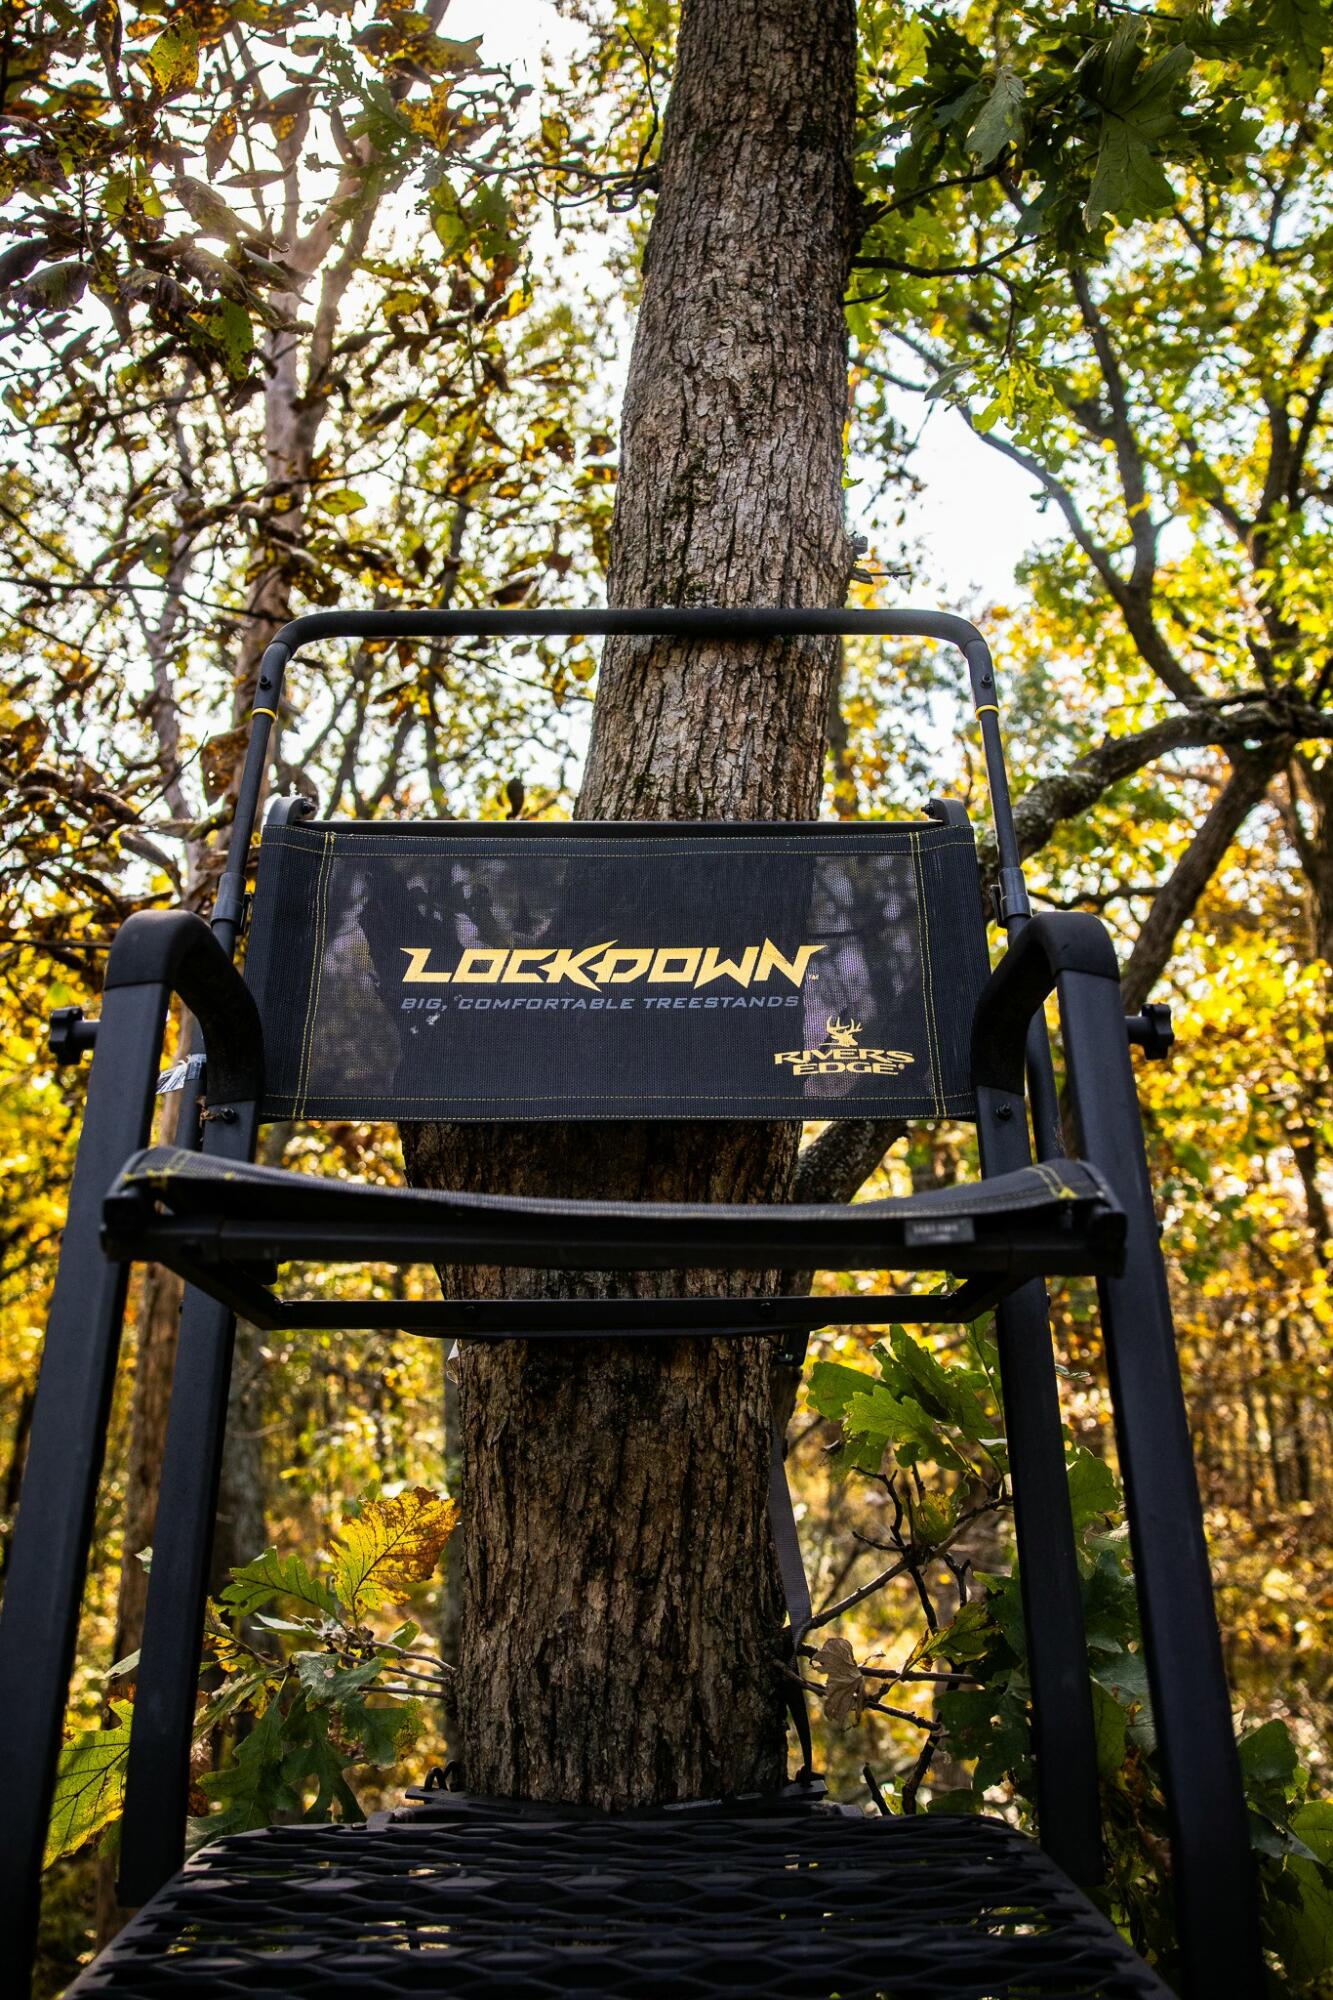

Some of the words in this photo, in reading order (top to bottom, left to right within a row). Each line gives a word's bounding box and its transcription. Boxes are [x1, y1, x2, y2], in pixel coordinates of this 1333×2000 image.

[400, 937, 828, 992] LOCKDOWN
[400, 998, 449, 1012] BIG,
[457, 998, 634, 1010] COMFORTABLE
[643, 995, 800, 1010] TREESTANDS
[774, 1048, 916, 1065] RIVERS
[792, 1061, 899, 1076] EDGE
